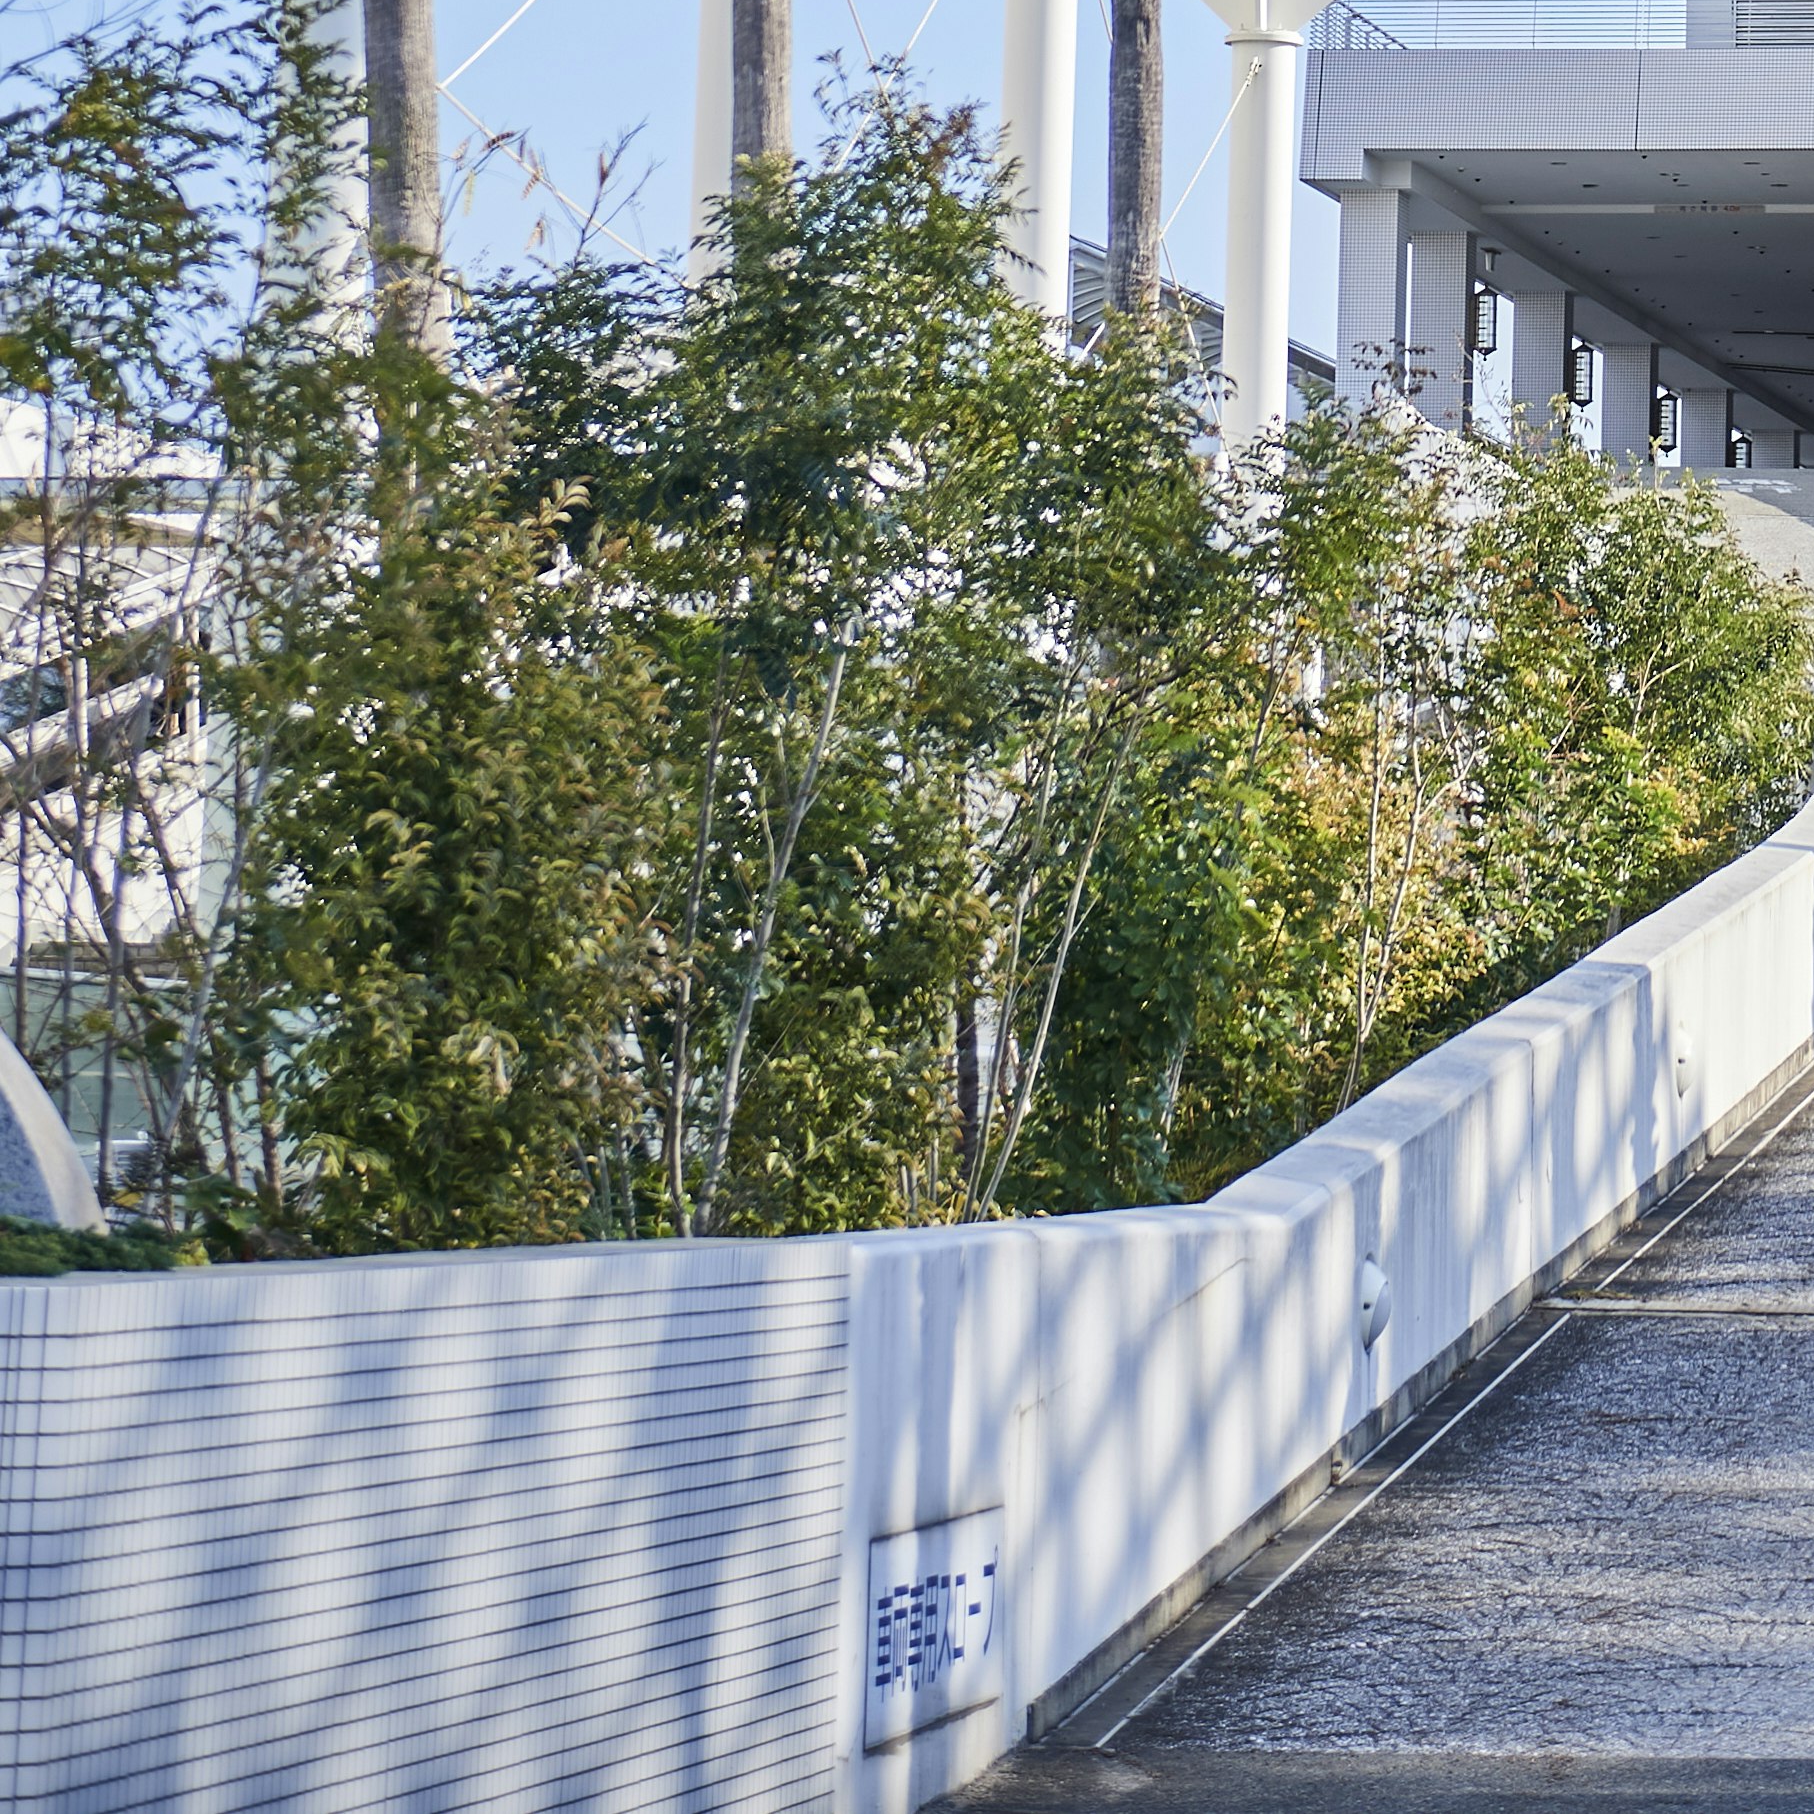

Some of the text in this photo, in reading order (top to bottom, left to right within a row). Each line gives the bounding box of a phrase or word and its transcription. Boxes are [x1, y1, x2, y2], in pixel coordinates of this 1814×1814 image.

[875, 1543, 999, 1703] 車両専用スロープ
